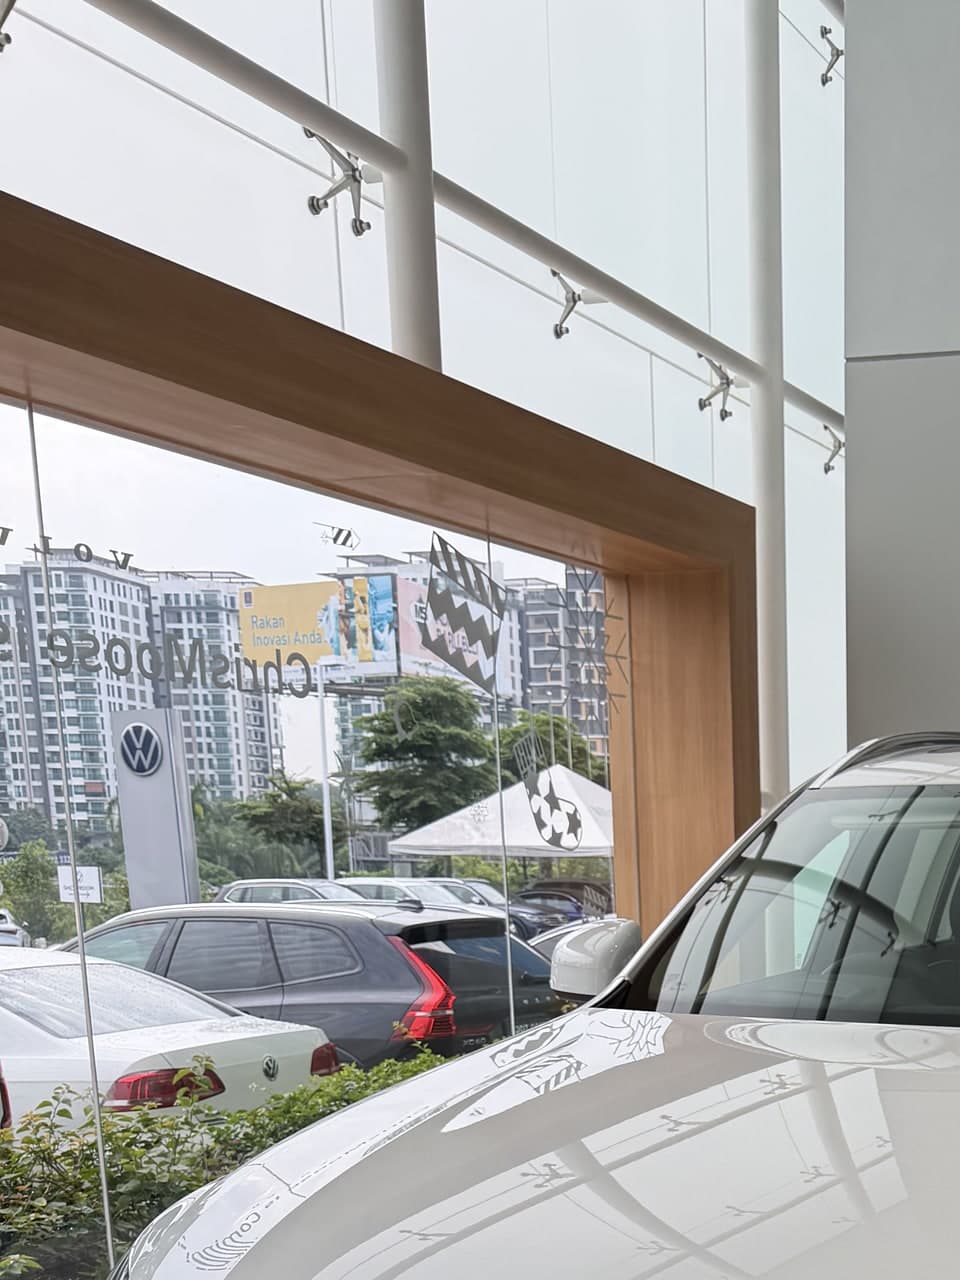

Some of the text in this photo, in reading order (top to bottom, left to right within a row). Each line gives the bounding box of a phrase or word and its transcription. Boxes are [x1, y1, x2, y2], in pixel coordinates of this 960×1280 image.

[251, 614, 285, 630] Rakan
[252, 630, 322, 648] Inovasi Anda
